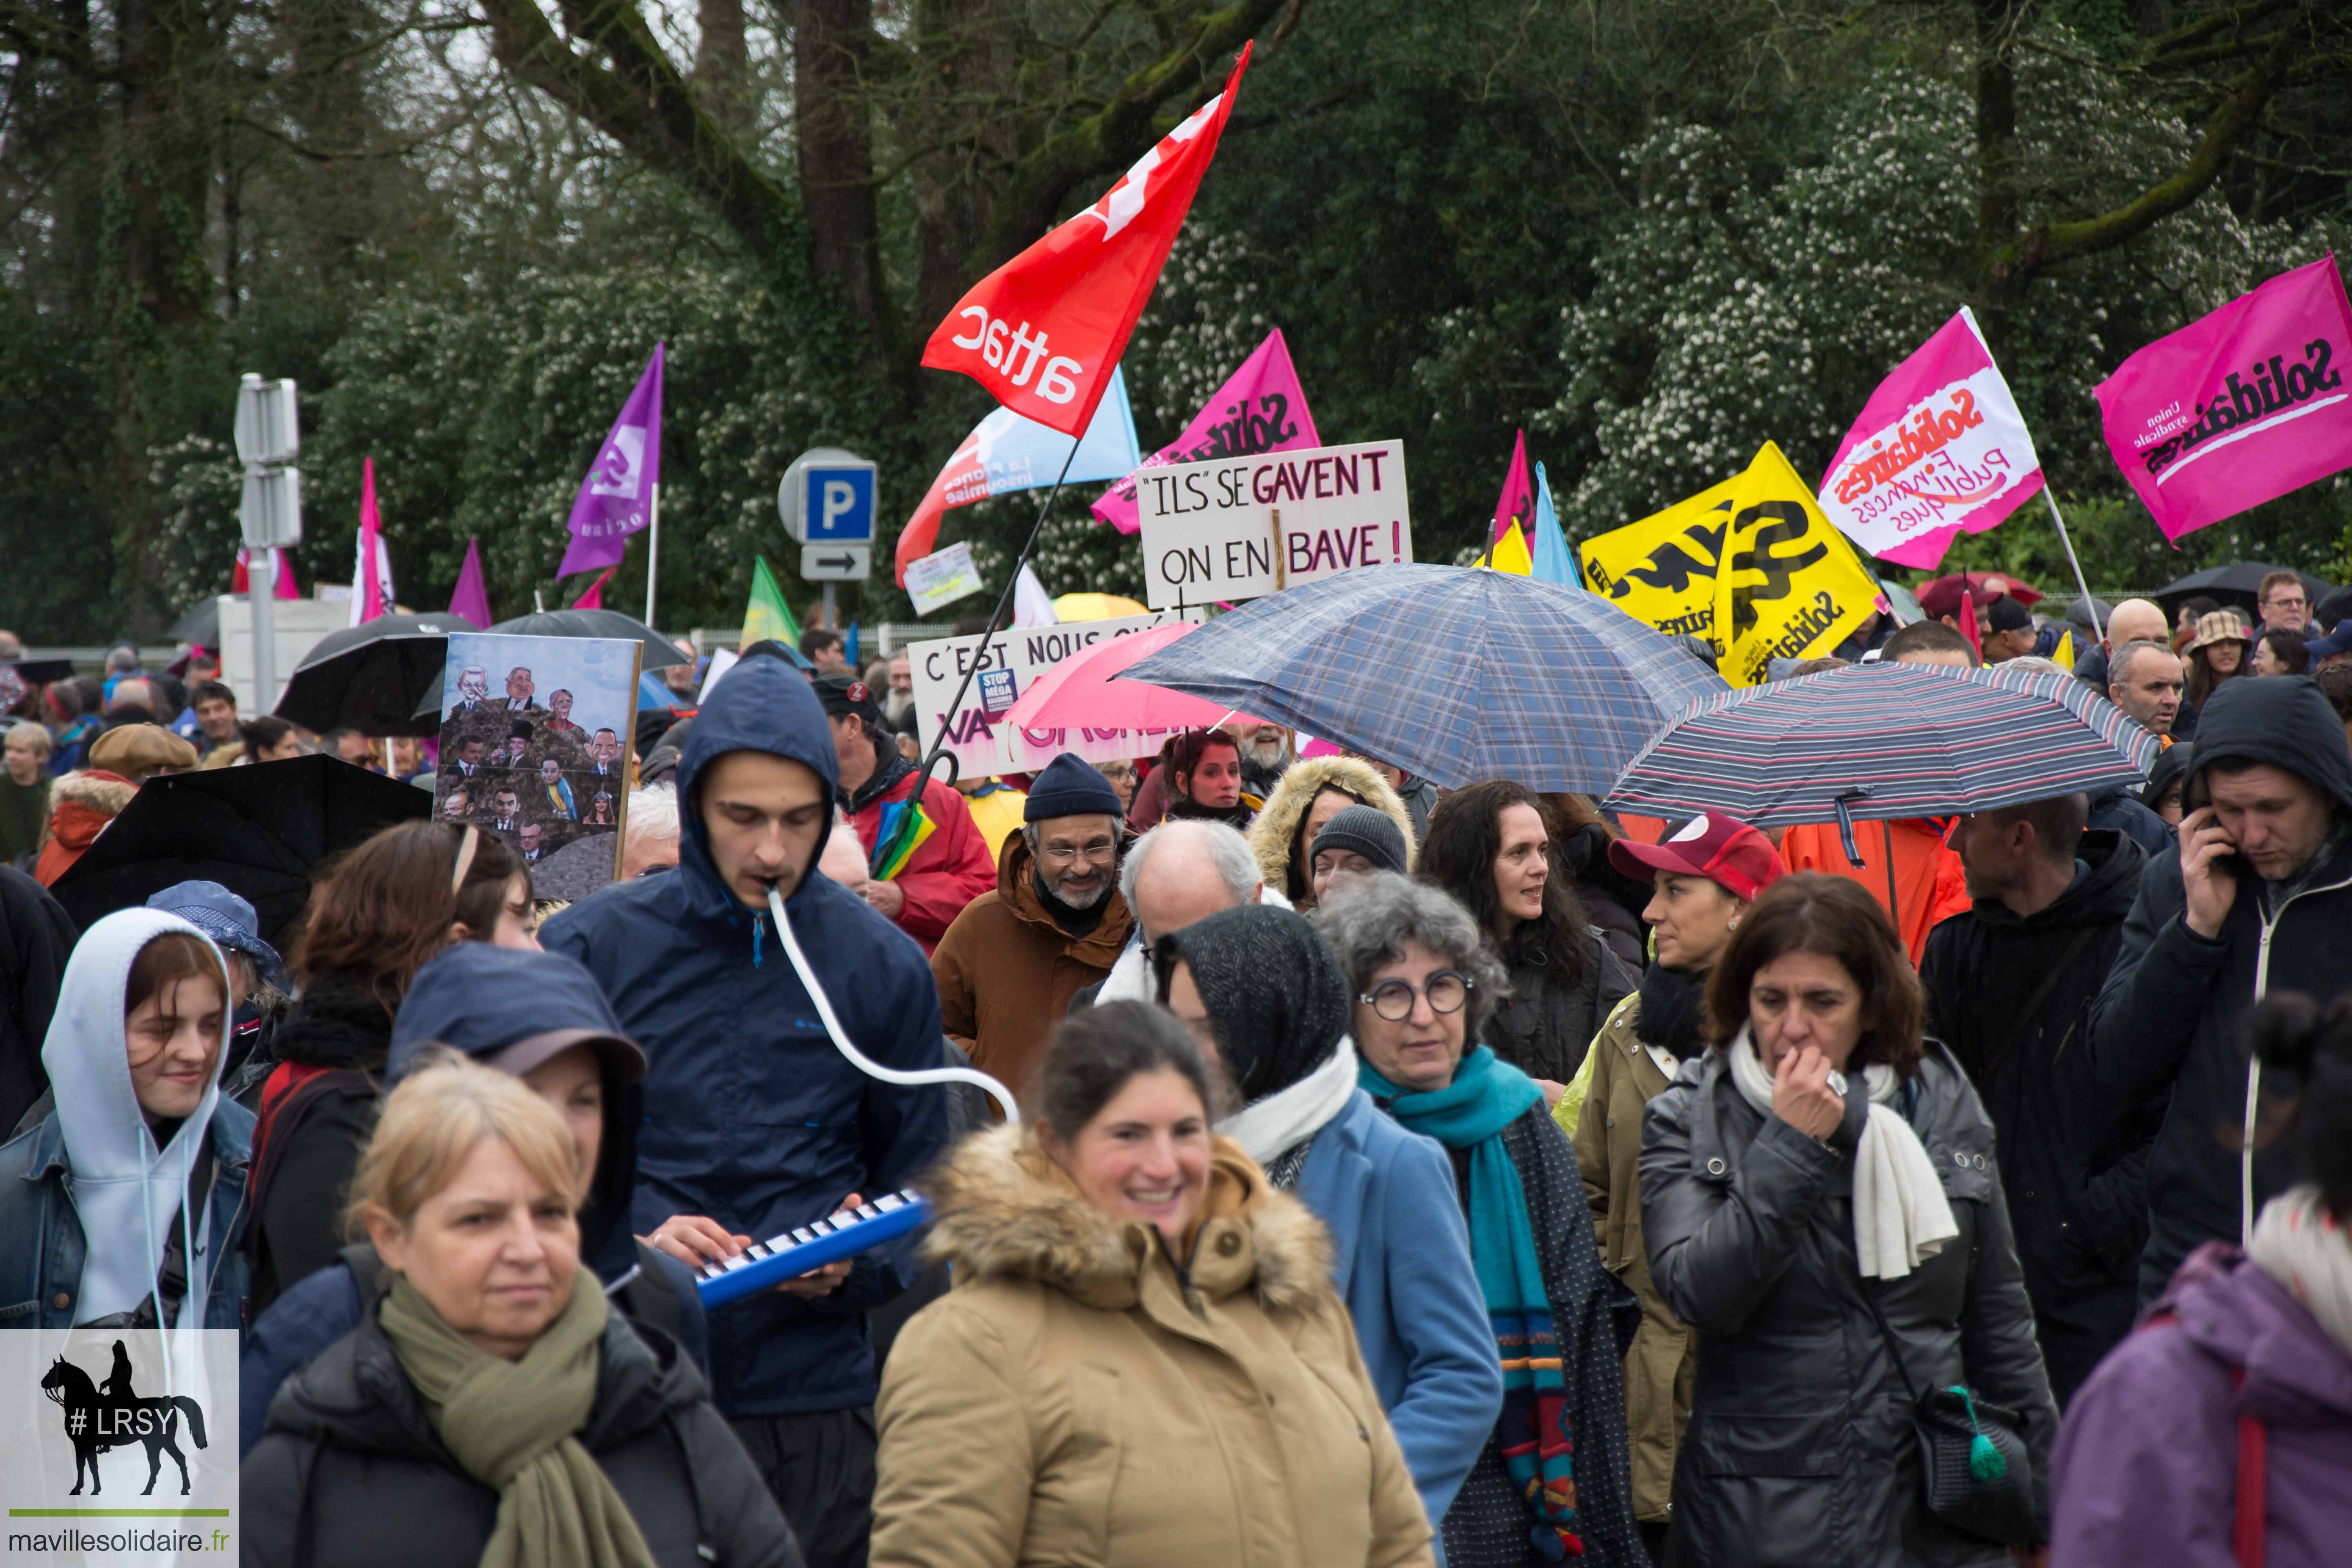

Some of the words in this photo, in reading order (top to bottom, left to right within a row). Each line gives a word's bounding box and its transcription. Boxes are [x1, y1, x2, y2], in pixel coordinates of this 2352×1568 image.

[1217, 467, 1249, 508] SE
[1252, 451, 1388, 505] GAVENT
[822, 481, 855, 530] P
[1161, 545, 1211, 584] ON
[1226, 537, 1269, 578] EN
[1288, 525, 1381, 573] BAVE
[926, 643, 1007, 681] C'EST
[983, 672, 1009, 686] STOP
[936, 708, 994, 744] VA
